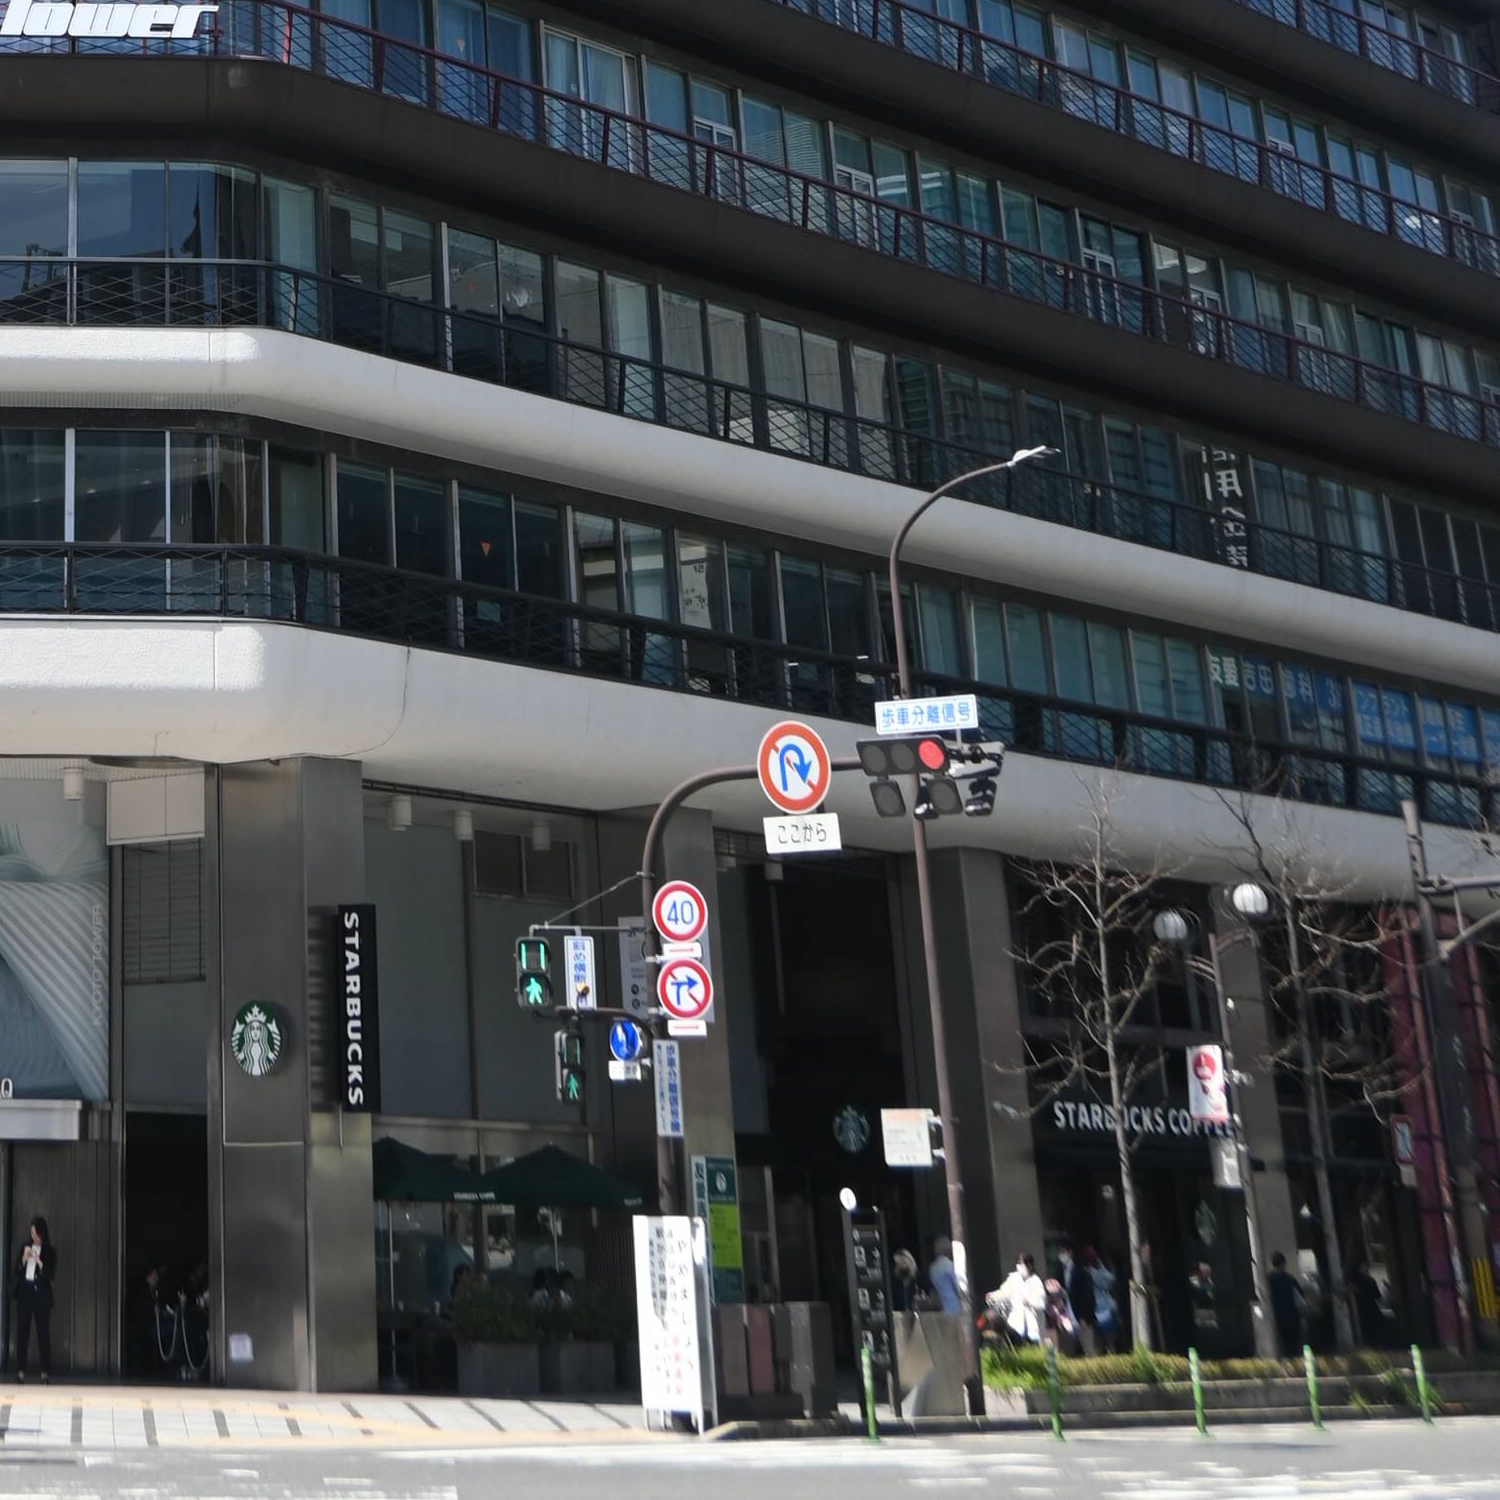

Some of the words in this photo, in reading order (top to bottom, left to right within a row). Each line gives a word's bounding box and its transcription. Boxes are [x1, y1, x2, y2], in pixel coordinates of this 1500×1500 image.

[881, 701, 972, 728] 歩車分離信号
[777, 823, 828, 845] ここから
[666, 899, 695, 926] 40
[344, 911, 364, 1106] STARBUCKS
